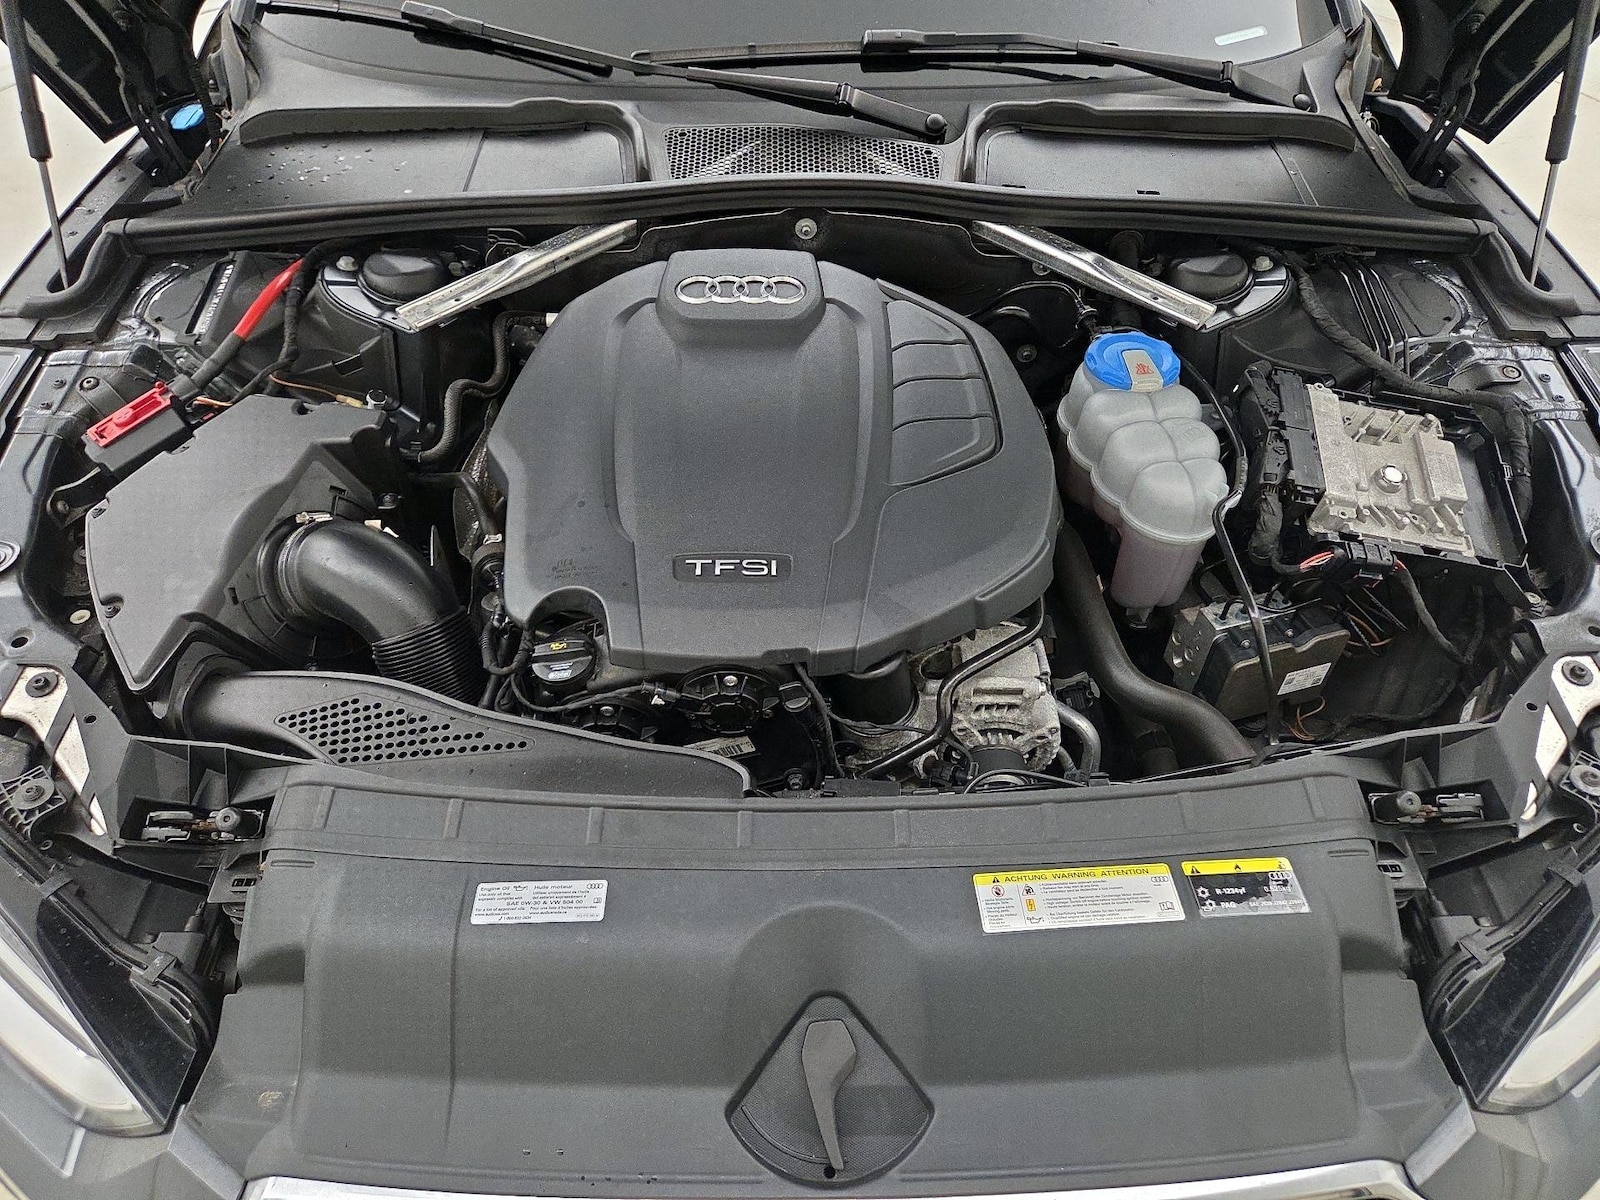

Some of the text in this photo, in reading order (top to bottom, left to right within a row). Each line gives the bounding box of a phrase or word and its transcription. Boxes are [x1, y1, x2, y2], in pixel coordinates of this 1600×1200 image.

[685, 559, 777, 576] TFSI
[1004, 868, 1150, 883] ACHTUNG WARNING ATTENTION
[1220, 901, 1237, 909] PAG
